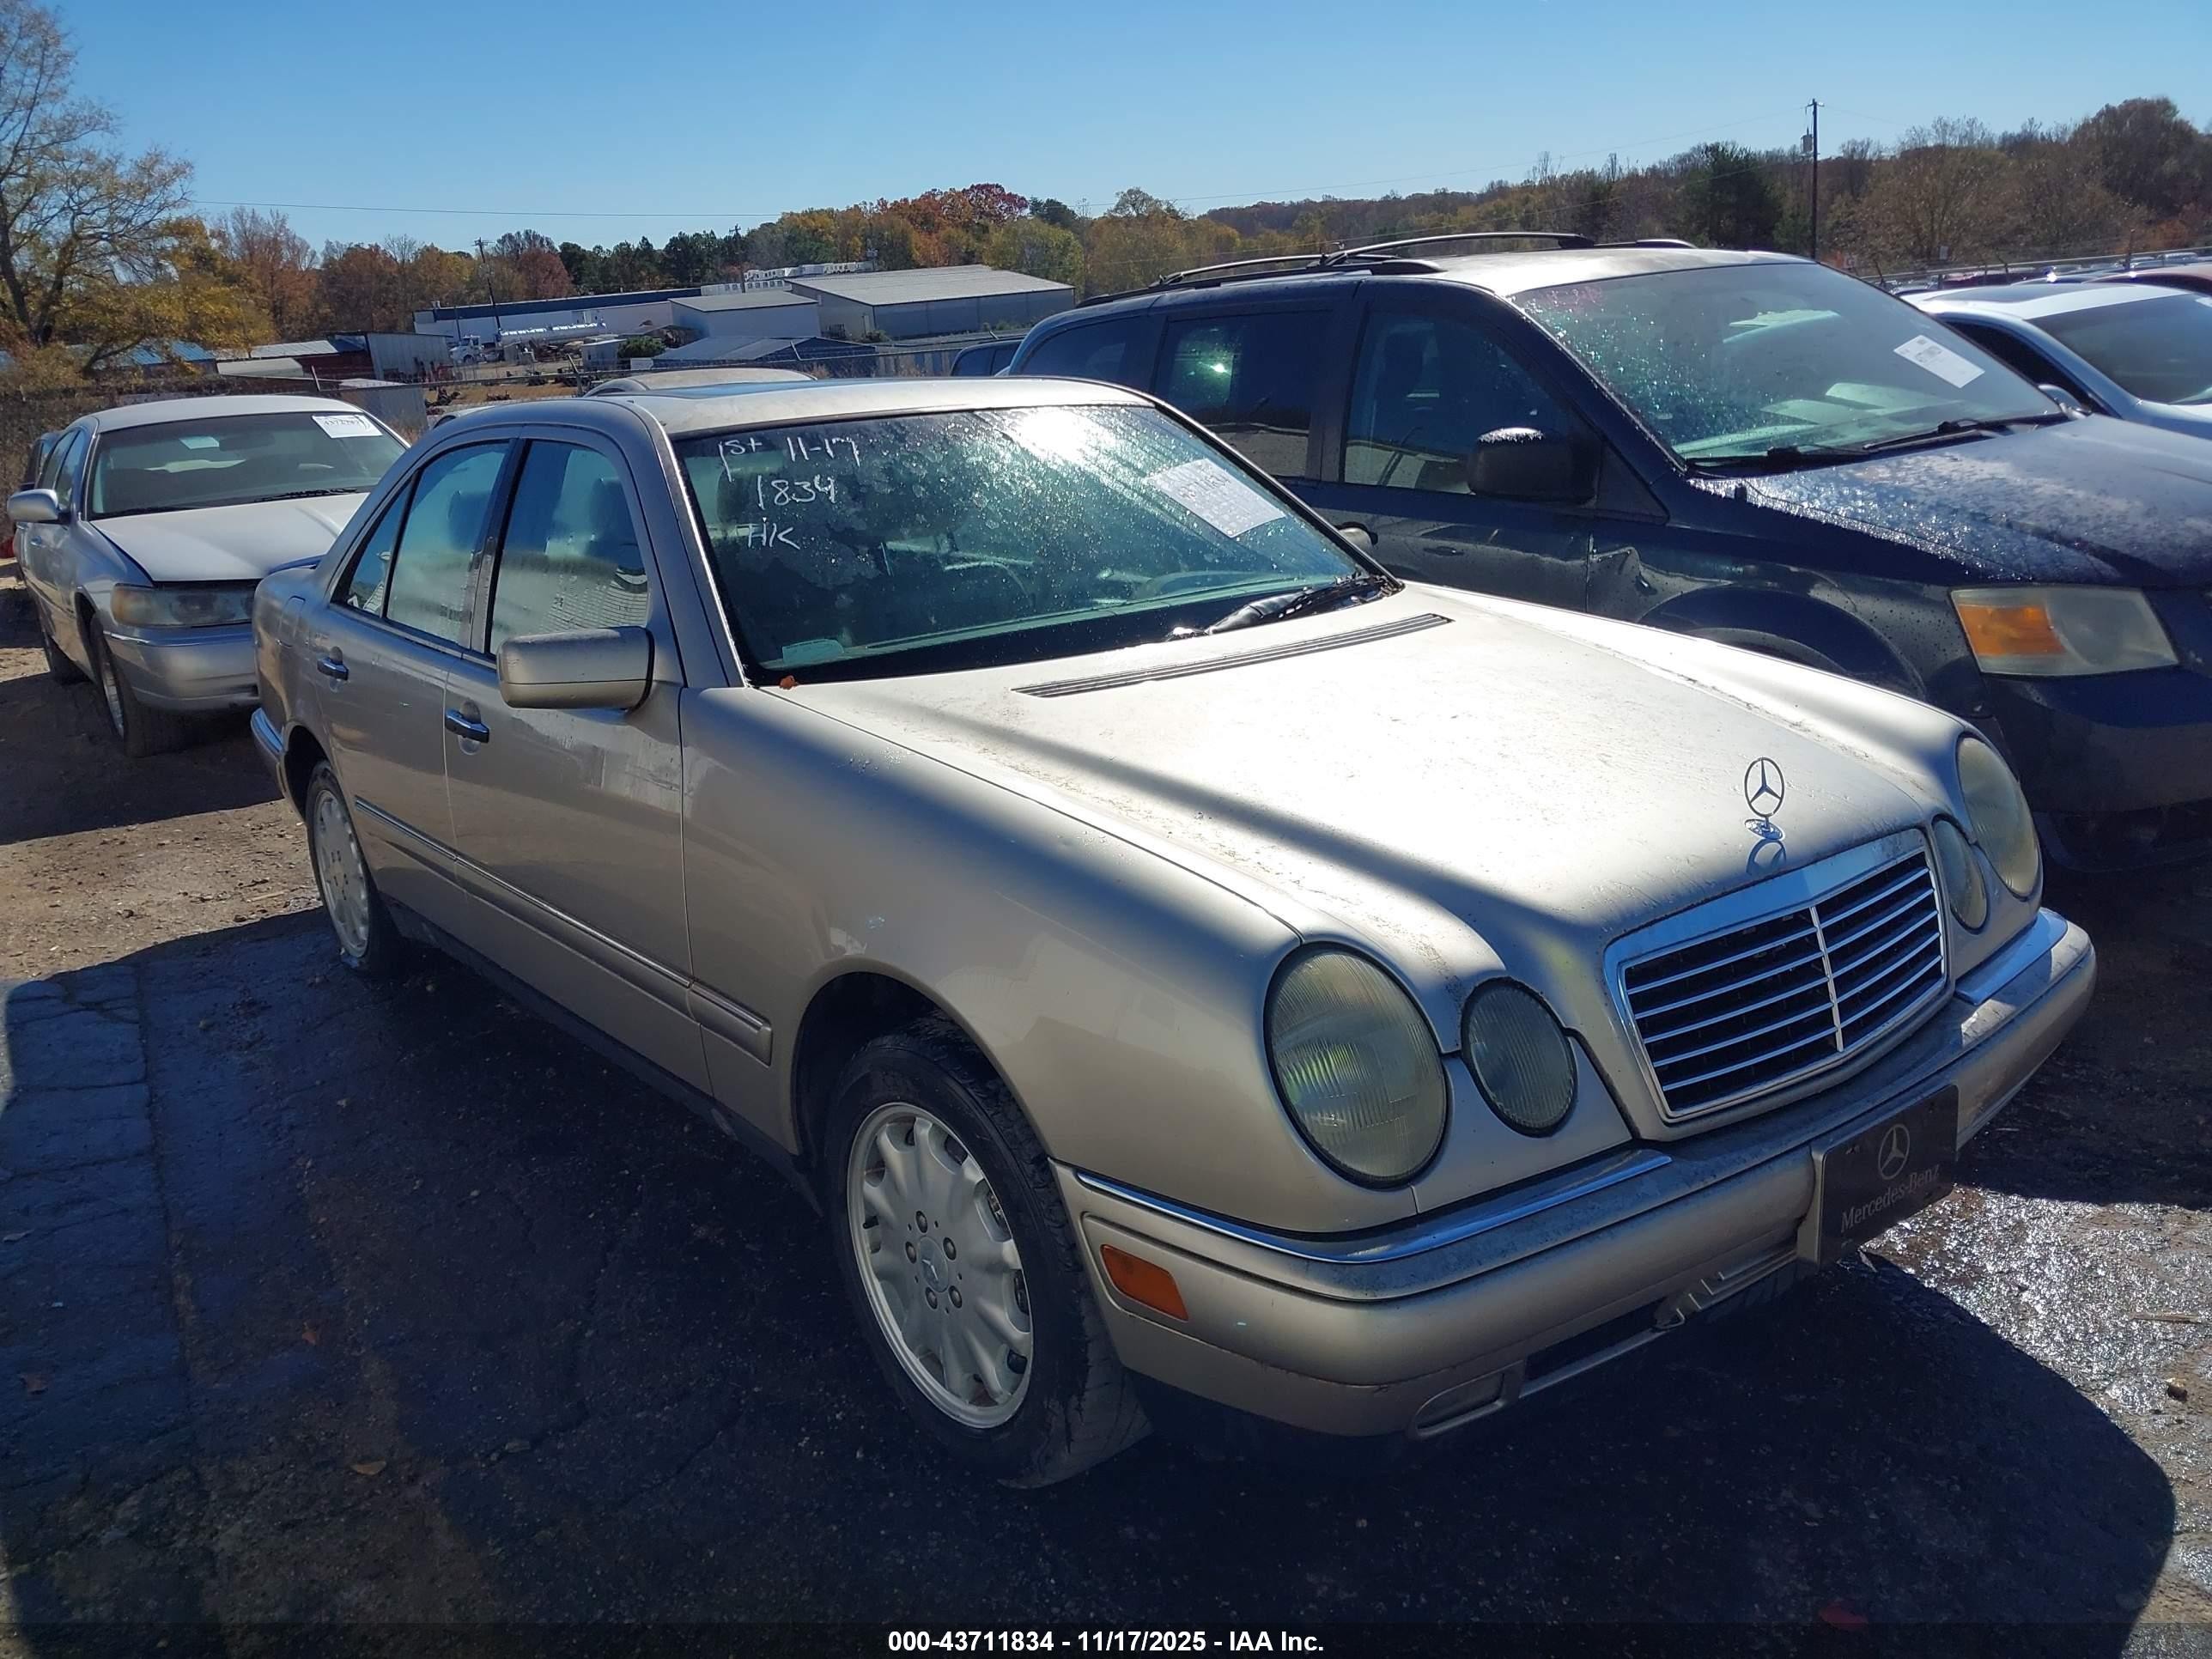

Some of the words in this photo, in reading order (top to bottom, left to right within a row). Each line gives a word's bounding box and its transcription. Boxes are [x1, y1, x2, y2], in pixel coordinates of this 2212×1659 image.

[787, 436, 860, 467] 11-17
[757, 474, 836, 511] 1834
[1840, 1164, 1940, 1233] Mercedes-Benz
